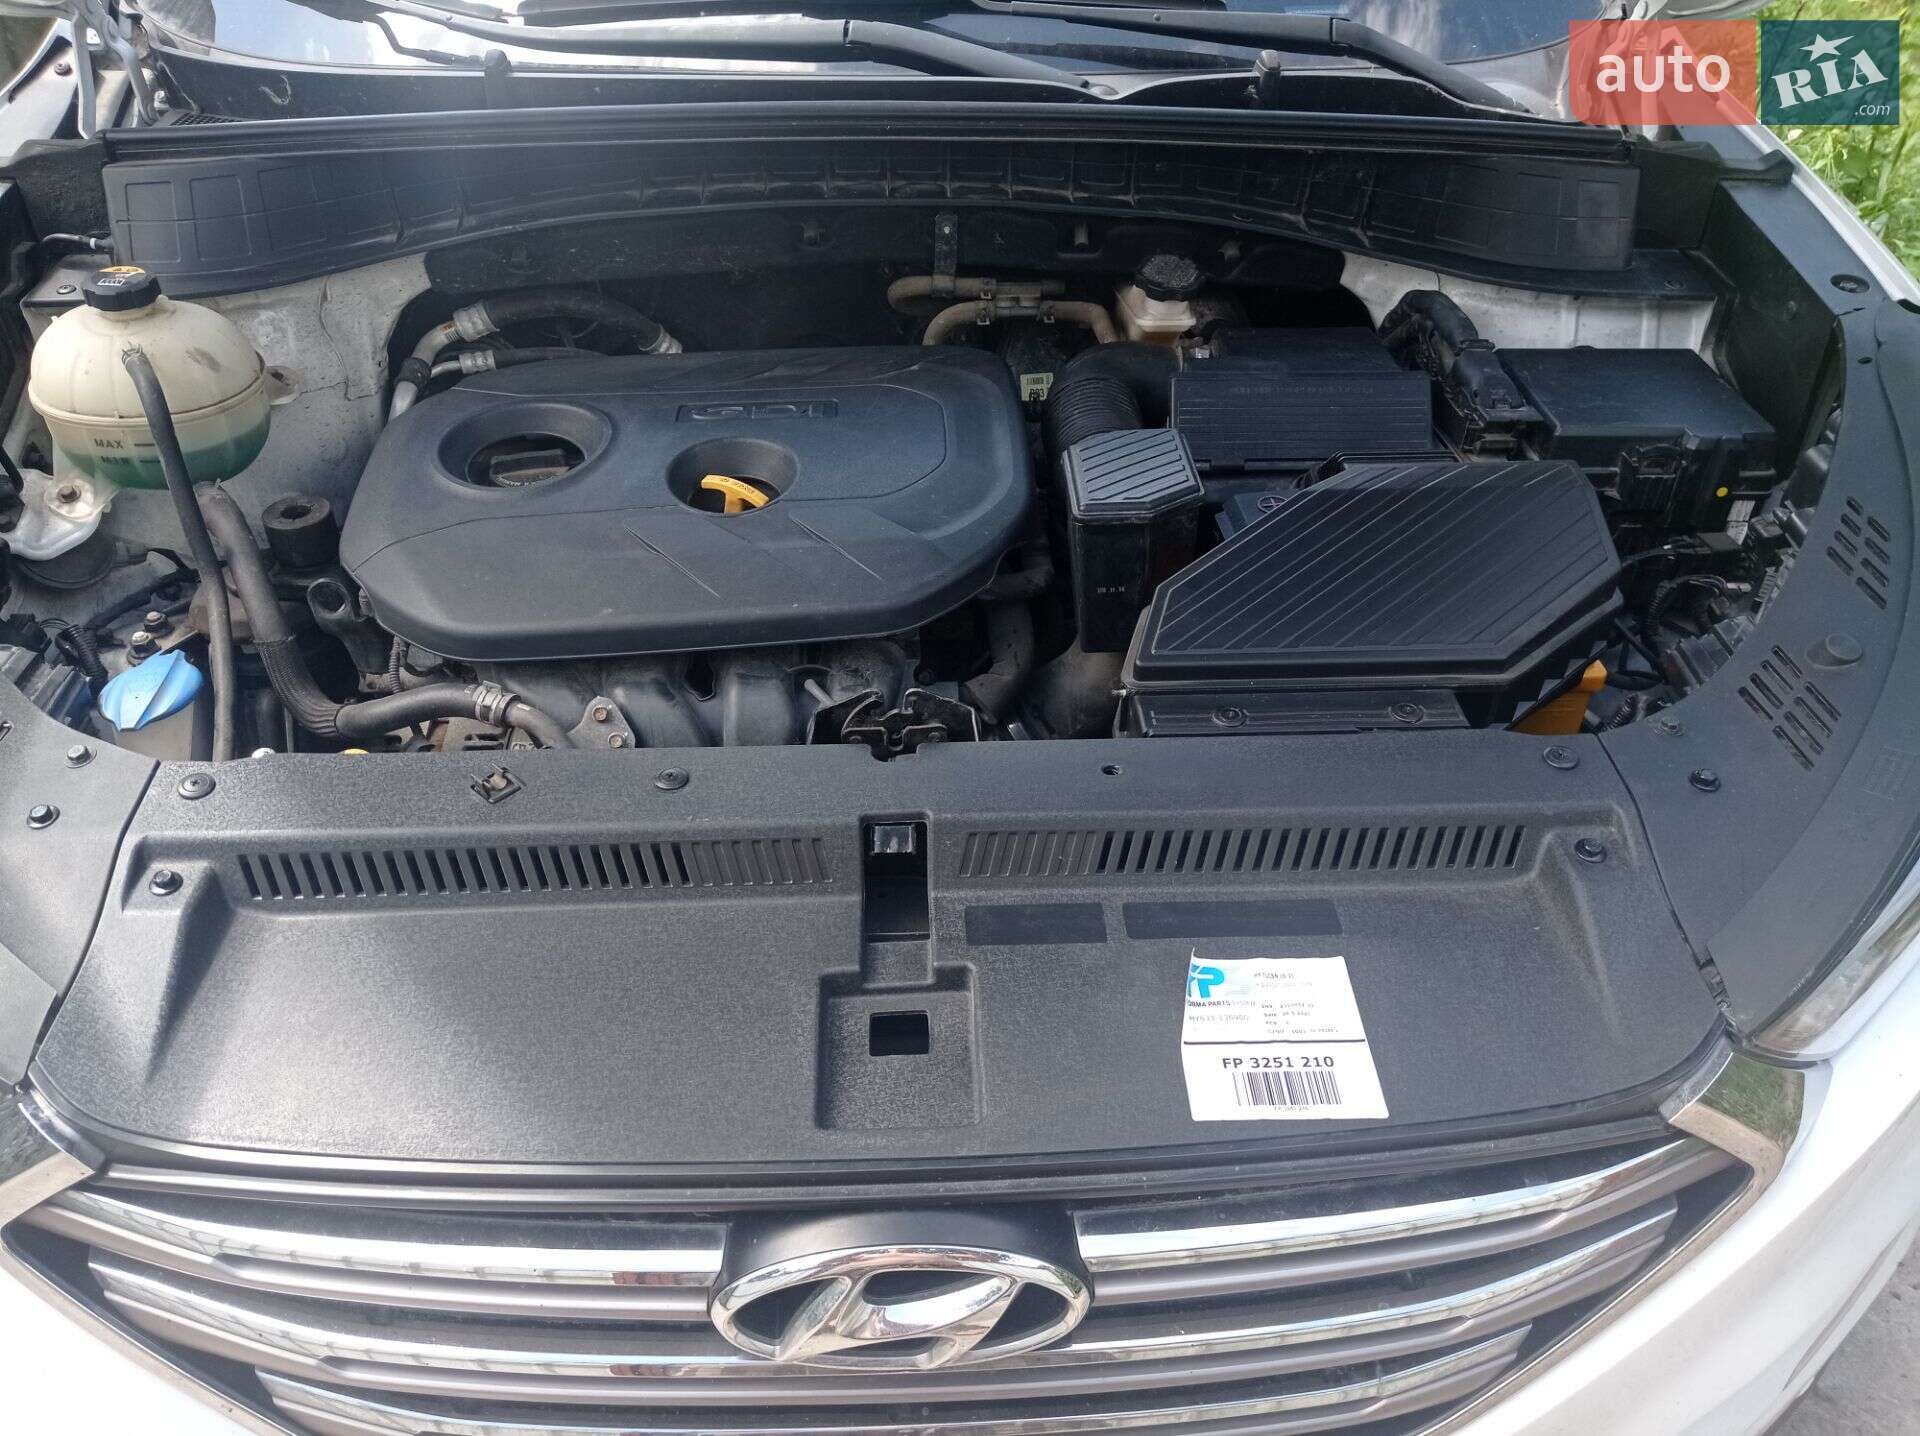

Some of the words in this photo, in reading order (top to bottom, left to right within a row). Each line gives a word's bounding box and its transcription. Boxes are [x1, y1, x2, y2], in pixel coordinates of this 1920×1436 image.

[93, 438, 124, 449] MAX
[1222, 1057, 1243, 1069] FP
[1250, 1057, 1294, 1068] 3251
[1302, 1056, 1335, 1068] 210
